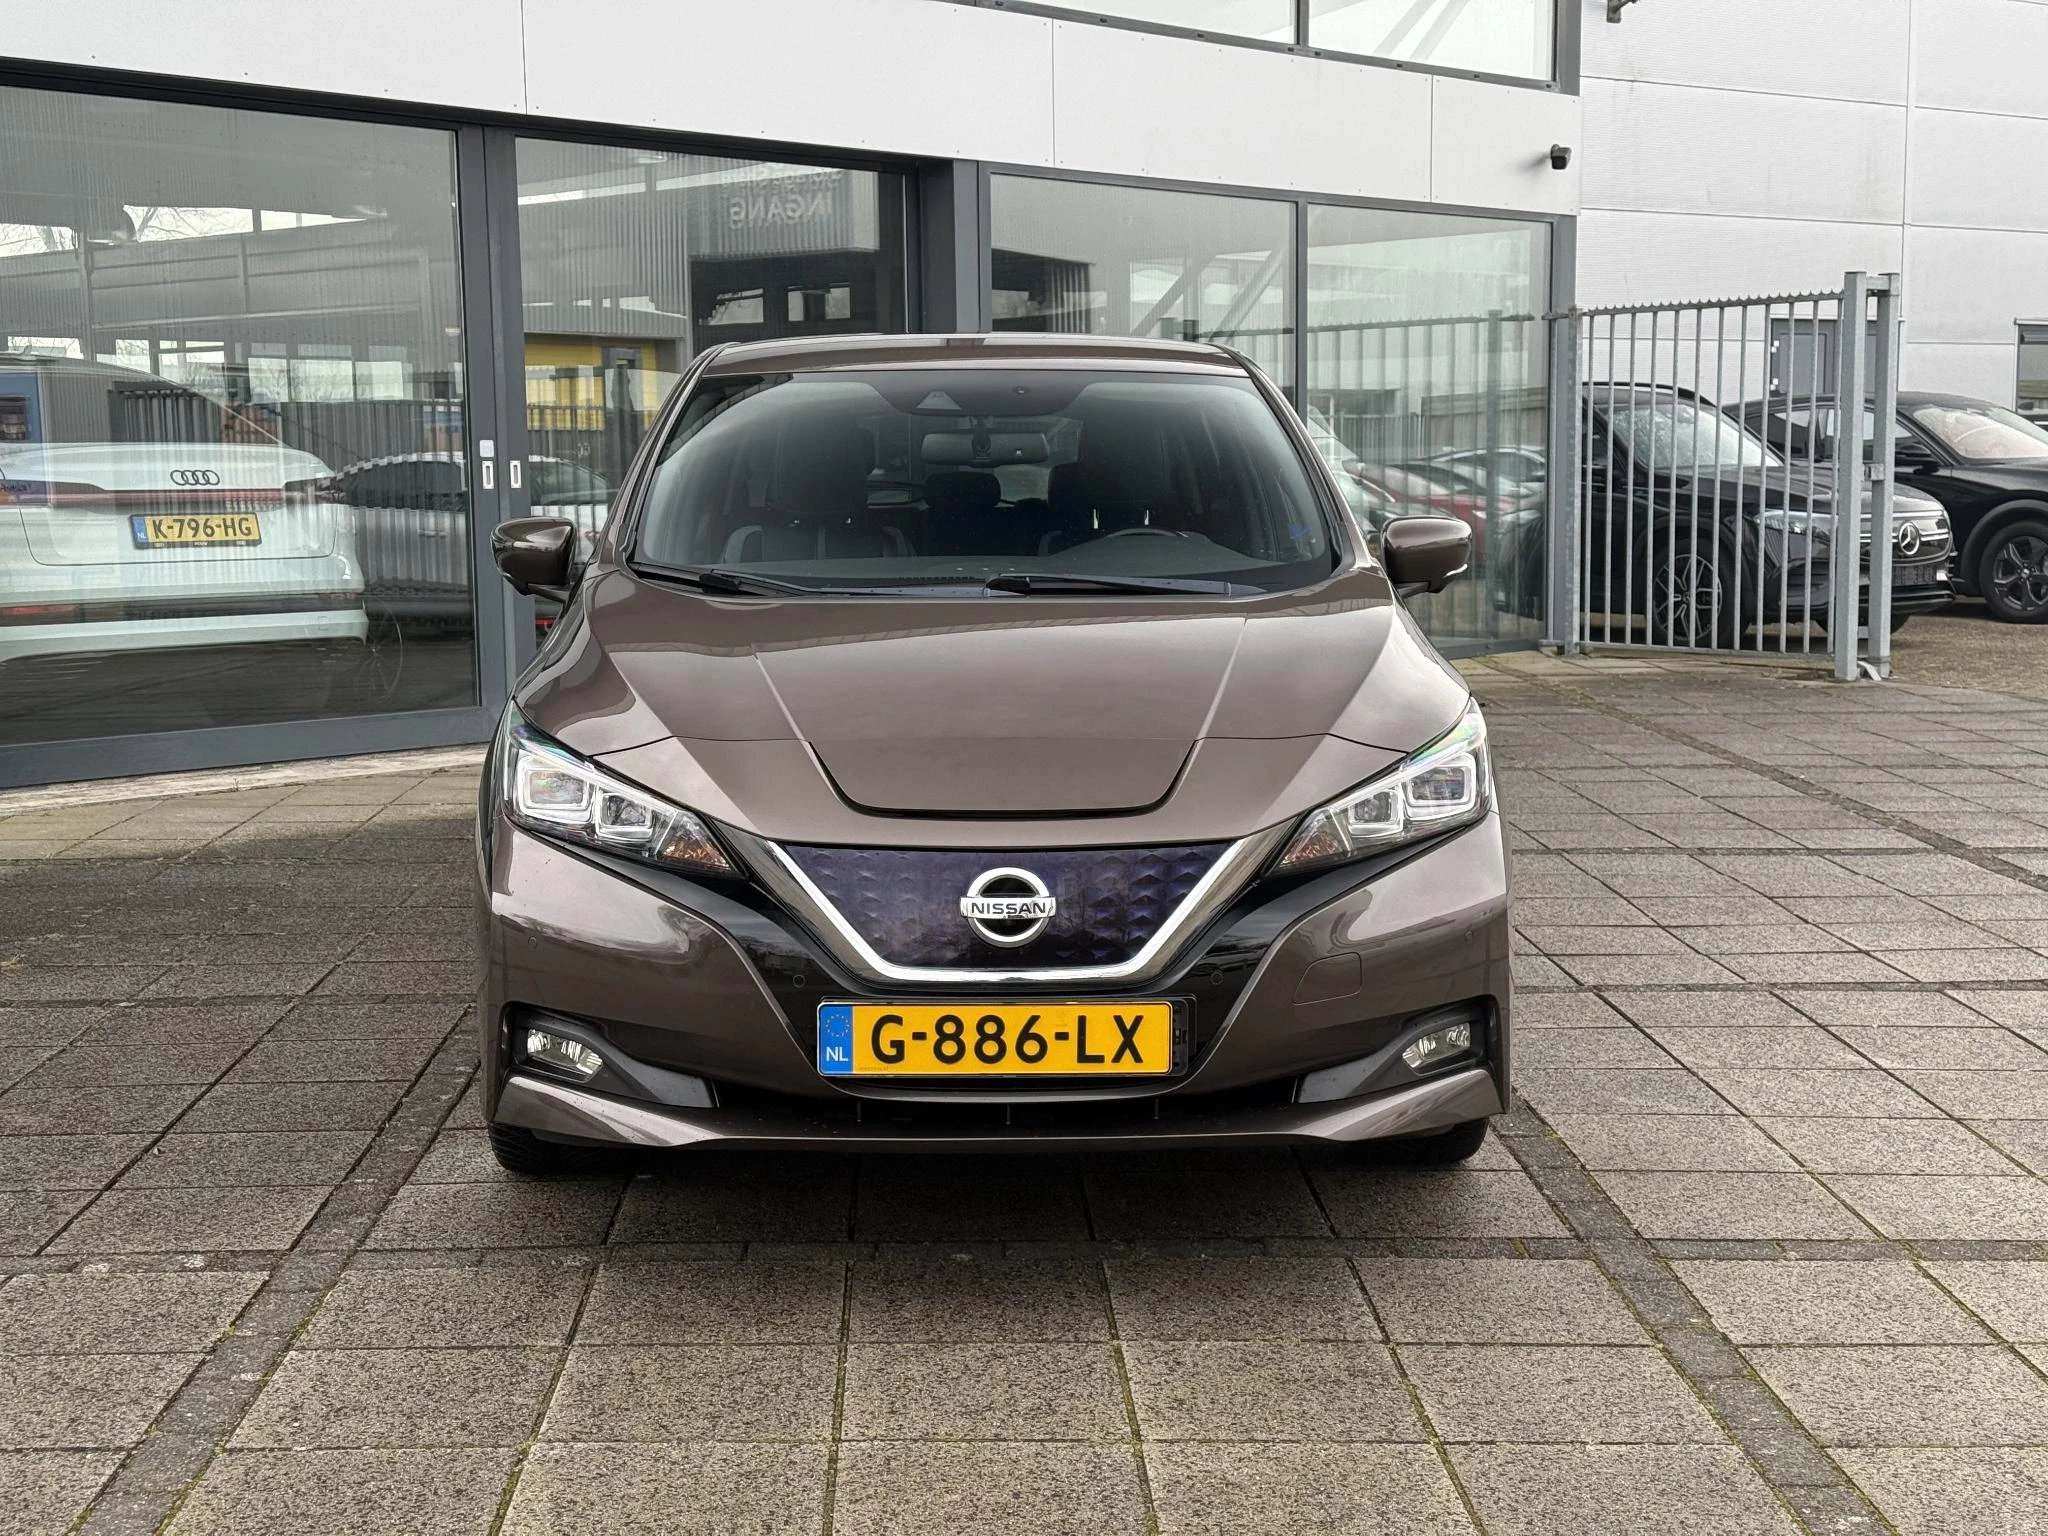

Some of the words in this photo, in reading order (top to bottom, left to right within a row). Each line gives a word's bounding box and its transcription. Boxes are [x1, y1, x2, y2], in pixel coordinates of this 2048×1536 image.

[151, 517, 252, 539] K-796-HG
[971, 902, 1046, 915] NISSAN
[871, 1014, 1144, 1064] G-886-LX
[825, 1046, 849, 1062] NL
